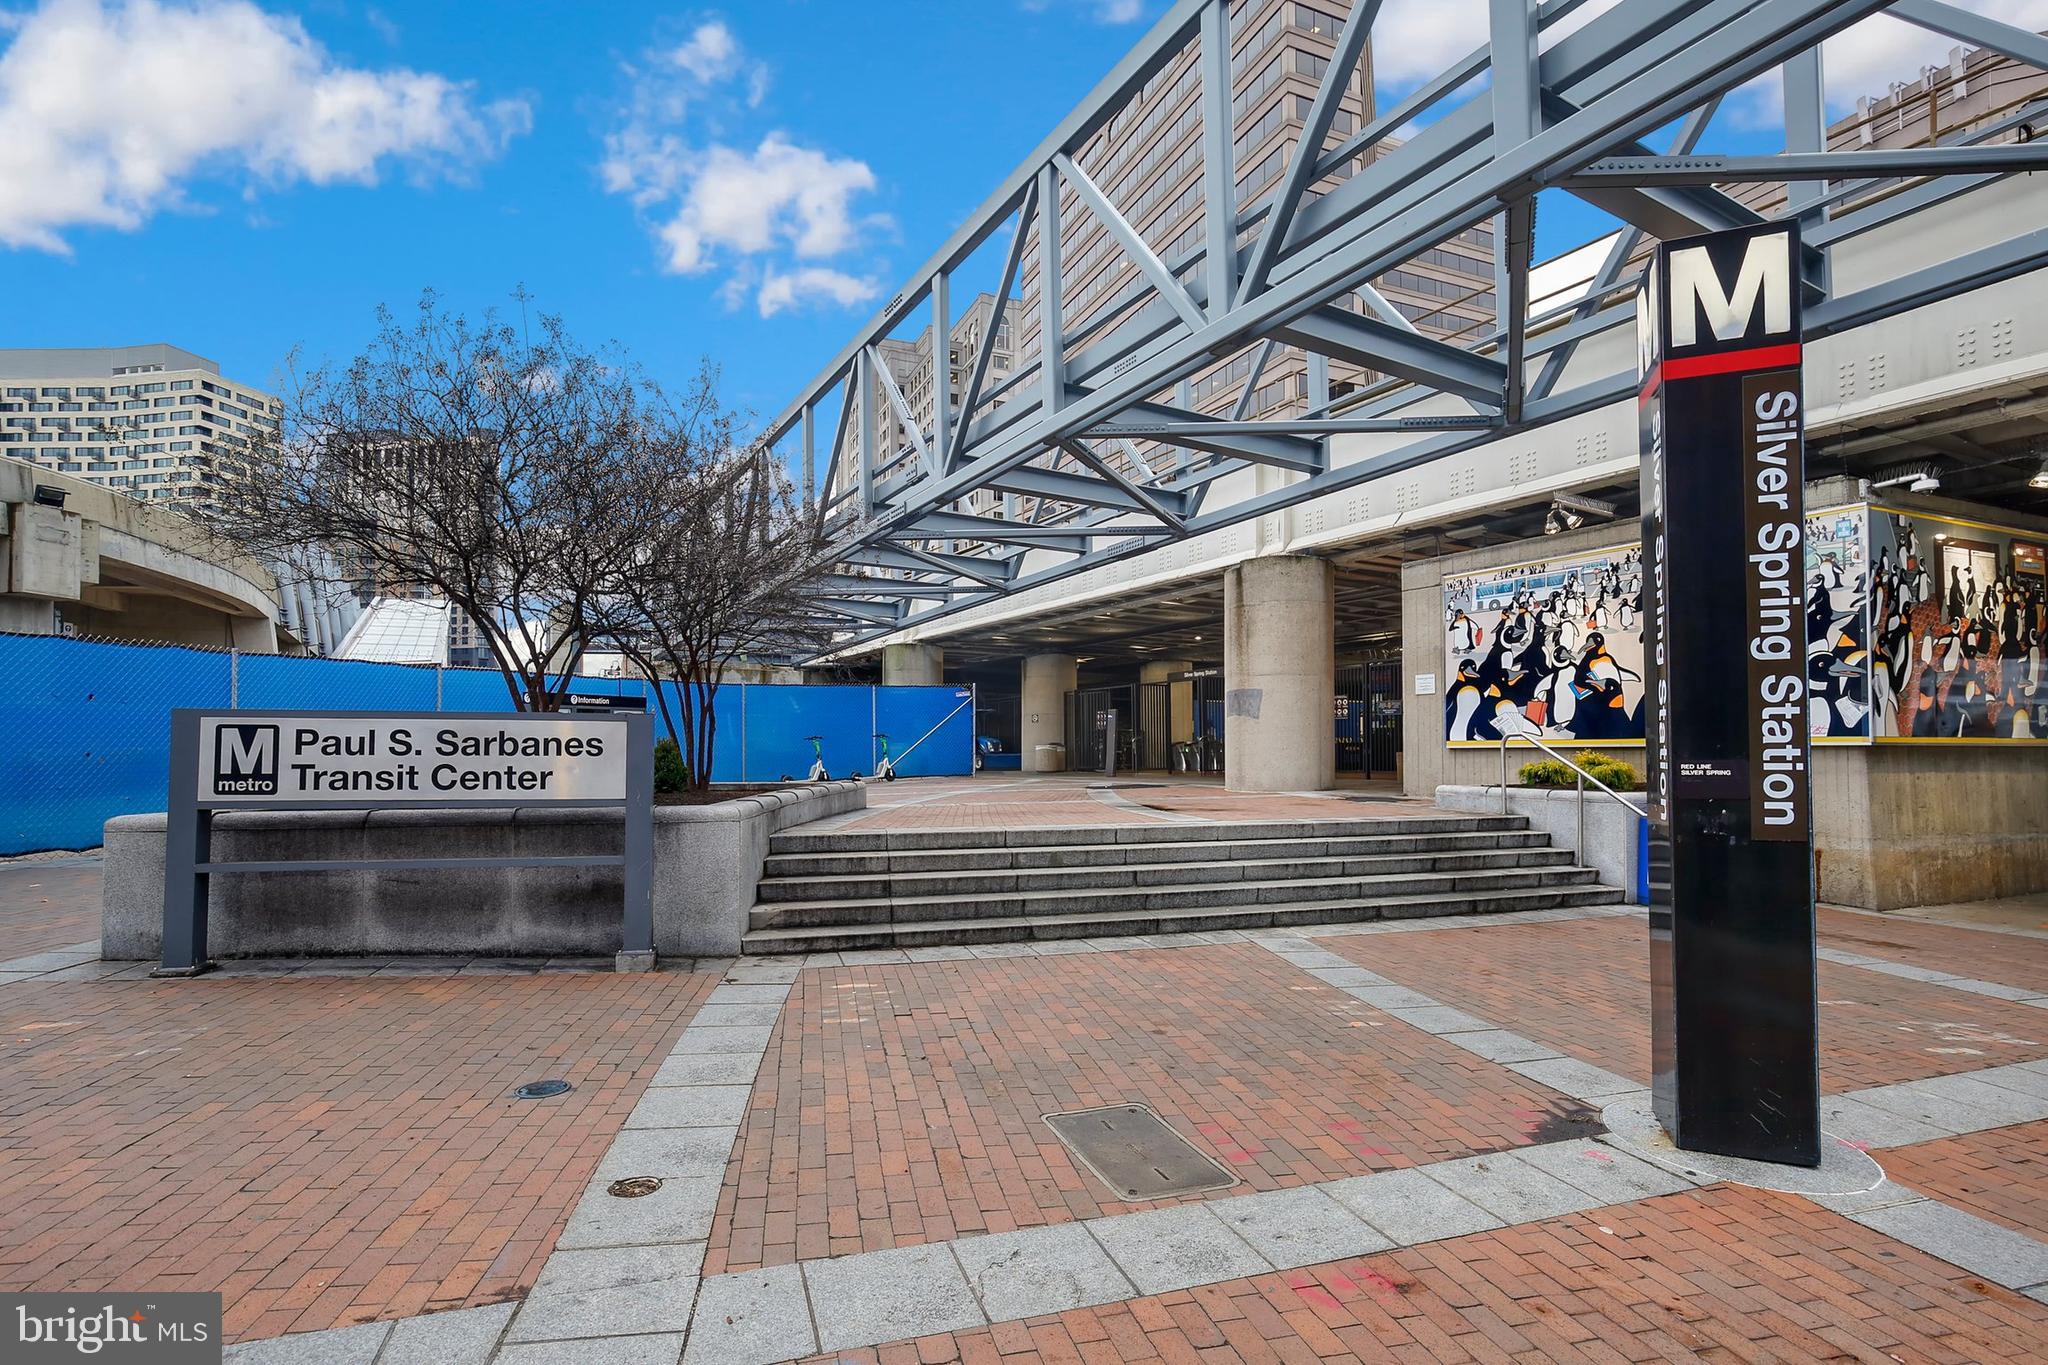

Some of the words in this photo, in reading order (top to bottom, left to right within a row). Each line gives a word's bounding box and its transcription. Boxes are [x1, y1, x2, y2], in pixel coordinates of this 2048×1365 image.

[1636, 258, 1659, 384] M
[1670, 231, 1790, 348] M
[1652, 410, 1662, 524] Silver
[1754, 390, 1798, 510] Silver
[1654, 535, 1665, 666] Spring
[1749, 522, 1801, 661] Spring
[219, 727, 274, 775] M
[294, 728, 376, 757] Paul
[388, 729, 422, 757] S.
[435, 730, 604, 758] Sarbanes
[578, 696, 610, 705] Information
[1658, 679, 1669, 821] Station
[1760, 674, 1804, 826] Station
[218, 779, 274, 793] metro
[291, 764, 419, 791] Transit
[430, 764, 553, 791] Center
